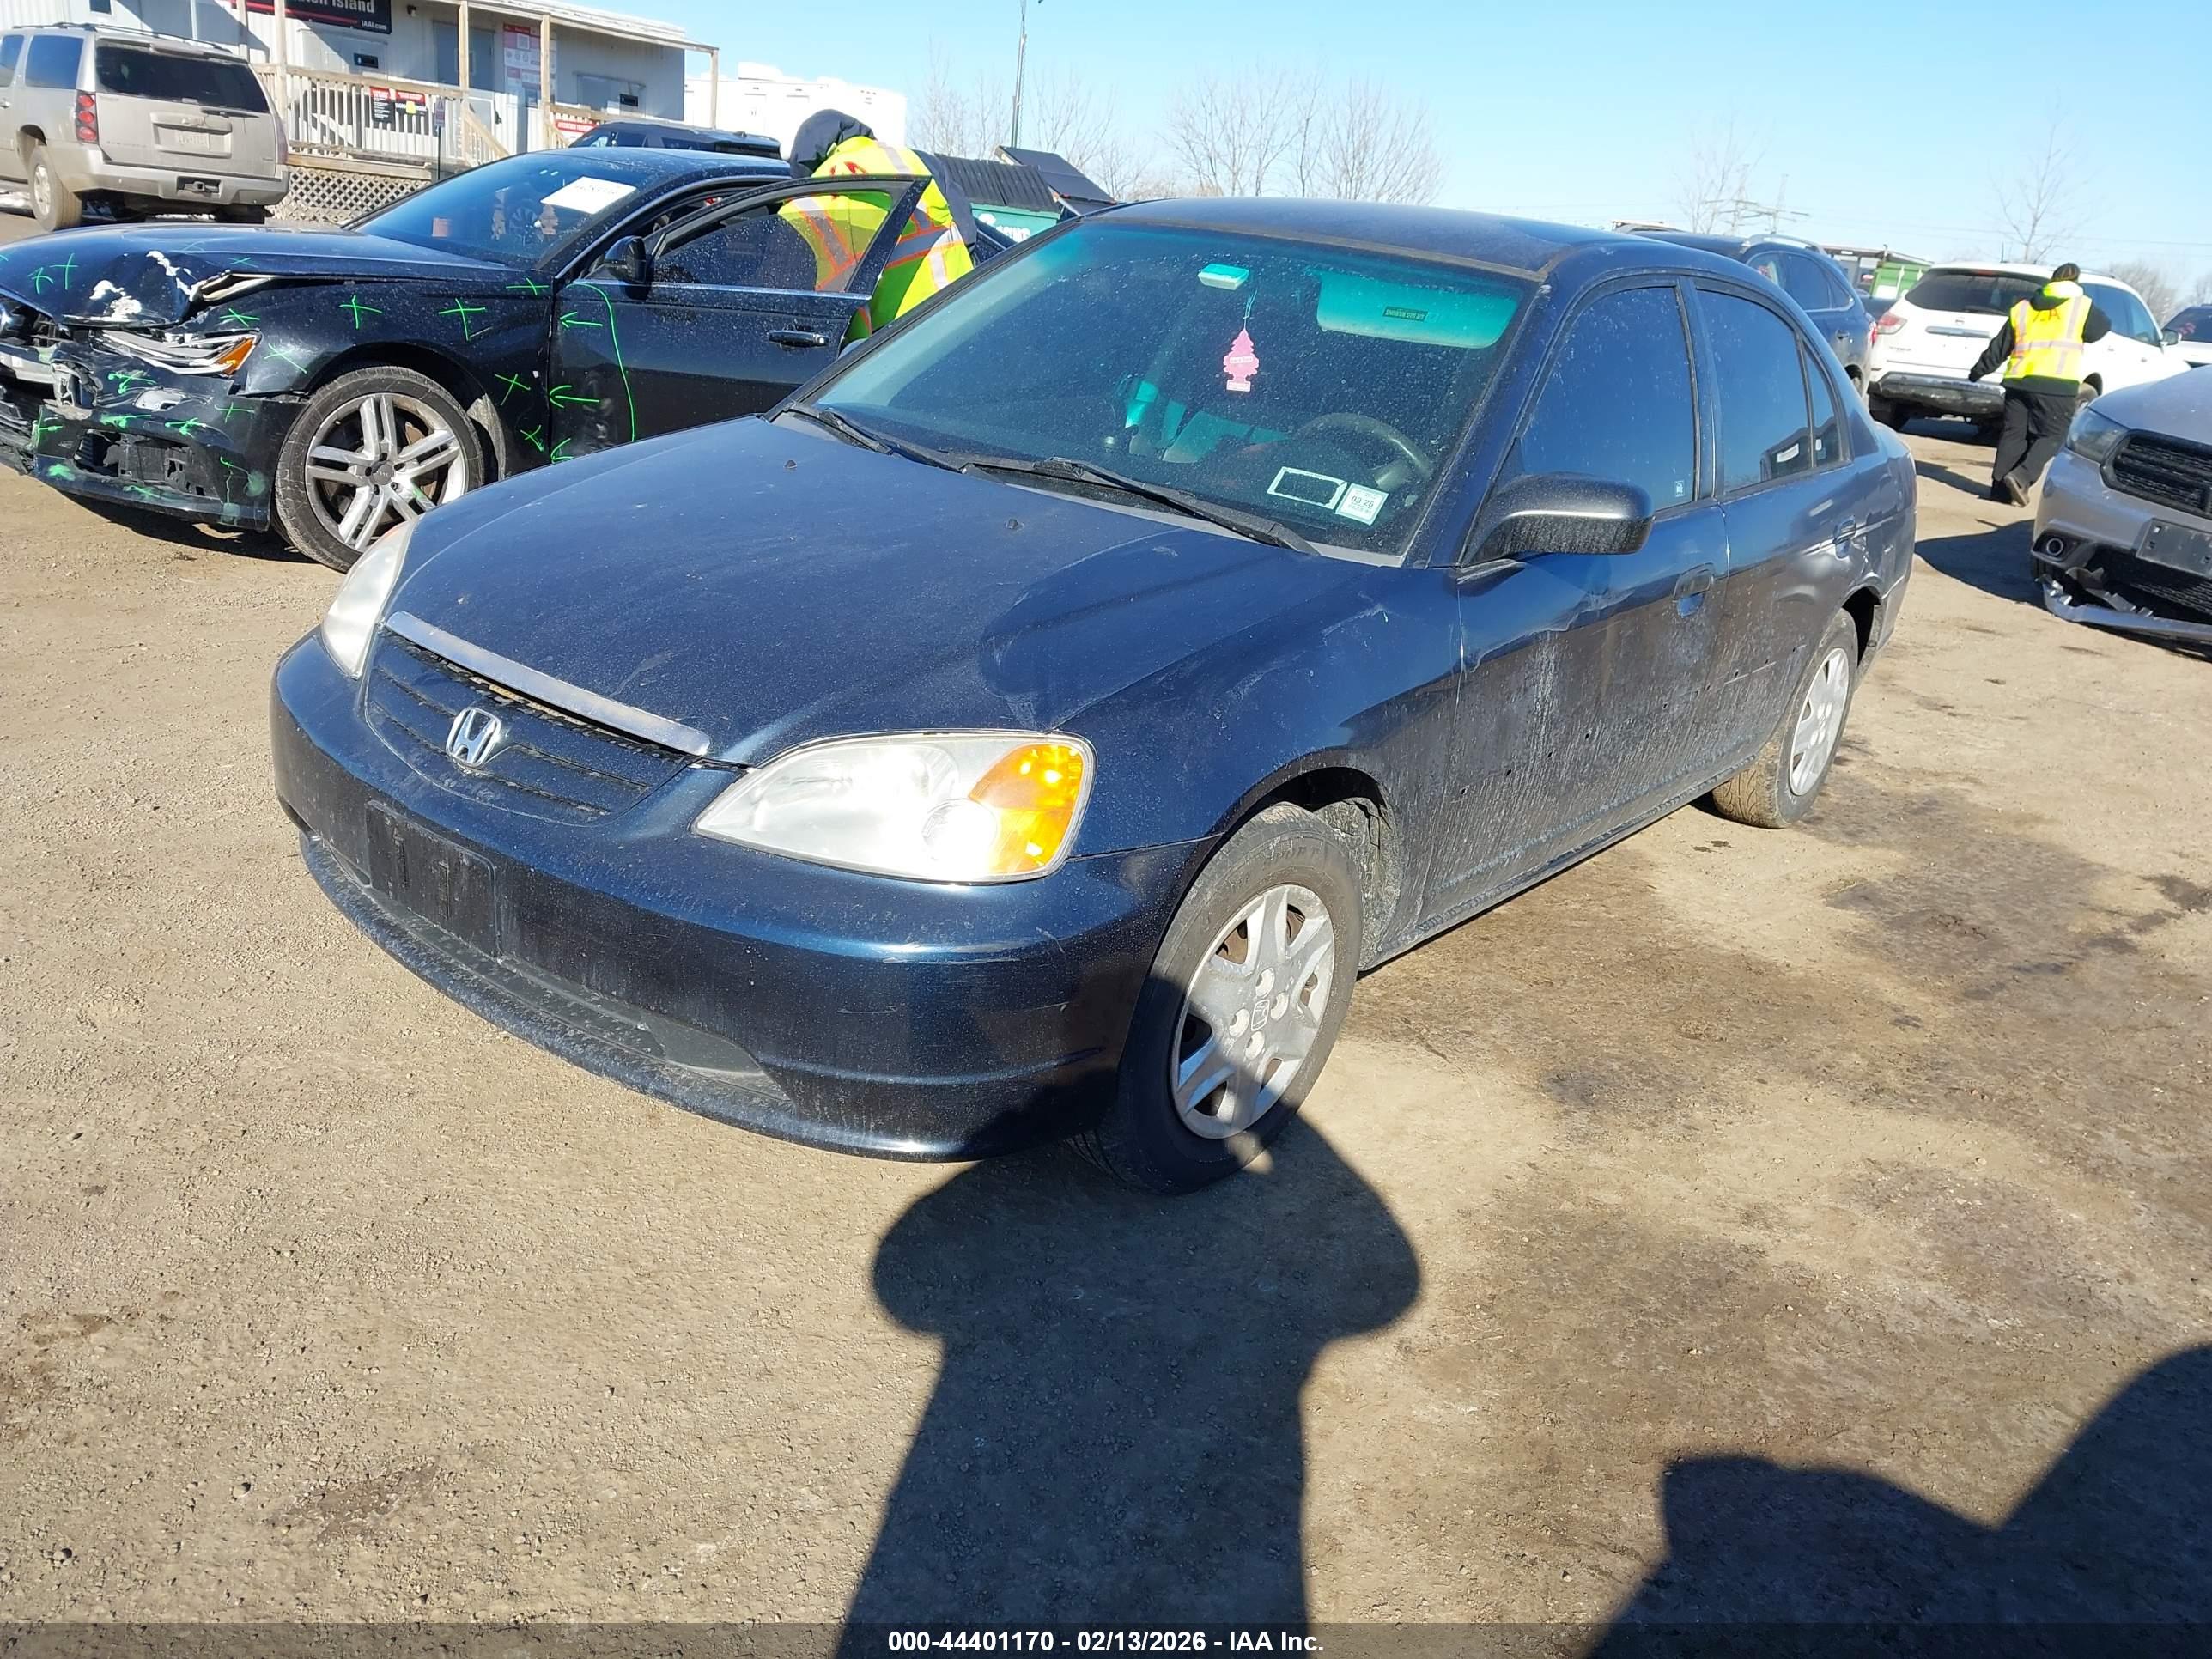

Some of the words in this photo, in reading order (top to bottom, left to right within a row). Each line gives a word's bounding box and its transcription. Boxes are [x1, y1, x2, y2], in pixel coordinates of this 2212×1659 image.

[361, 20, 387, 31] IAAI.com
[1351, 495, 1362, 504] 09
[1363, 499, 1374, 507] 26
